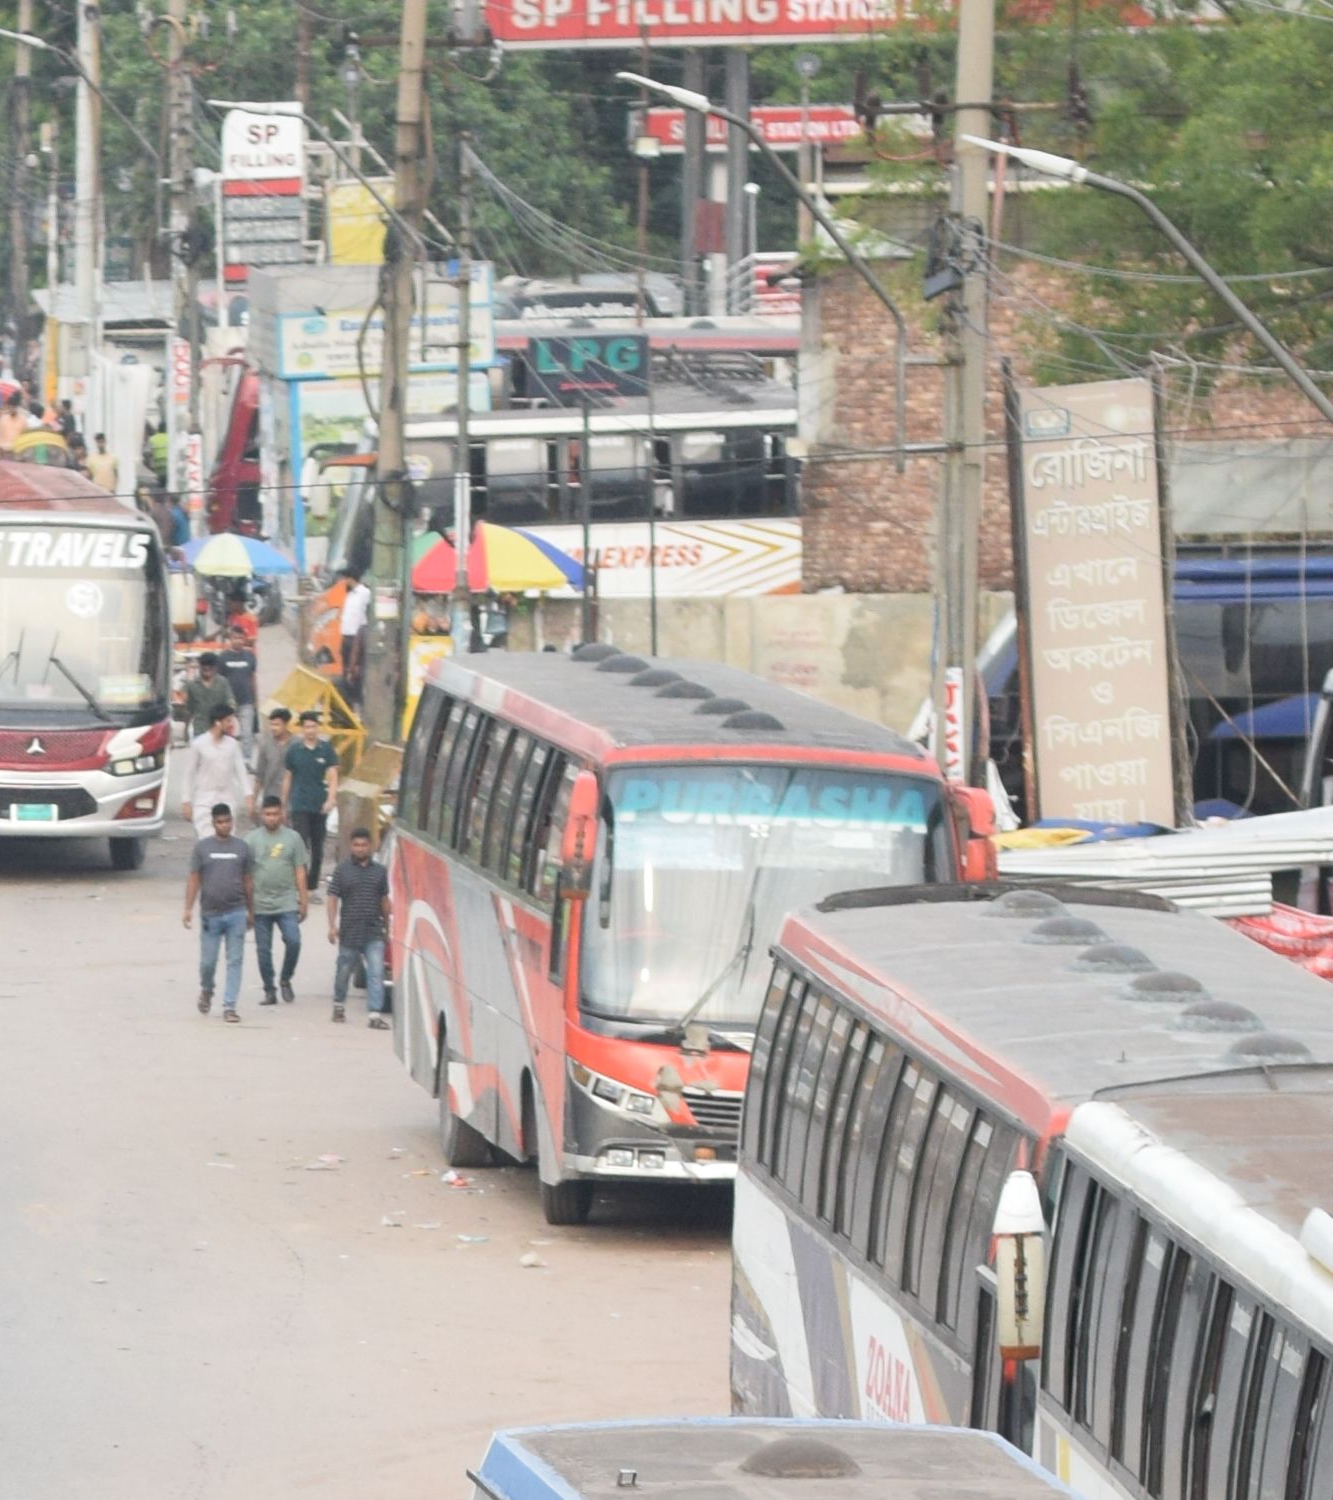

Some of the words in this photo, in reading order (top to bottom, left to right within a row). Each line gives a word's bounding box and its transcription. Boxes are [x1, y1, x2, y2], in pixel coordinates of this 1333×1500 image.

[510, 0, 567, 29] SP
[586, 0, 780, 25] FILLING
[247, 124, 279, 145] SP
[230, 155, 296, 168] FILLING
[535, 337, 640, 375] LPG
[1030, 437, 1149, 489] রোজিনা
[6, 531, 151, 568] TRAVELS
[595, 544, 704, 568] EXPRESS
[1045, 555, 1139, 590] এখানে
[1045, 597, 1147, 632] ডিজেল
[1041, 635, 1154, 673] অকটেন
[1090, 681, 1115, 704] ও
[1042, 706, 1162, 751] সিএনজি
[618, 779, 928, 834] PURBASHA
